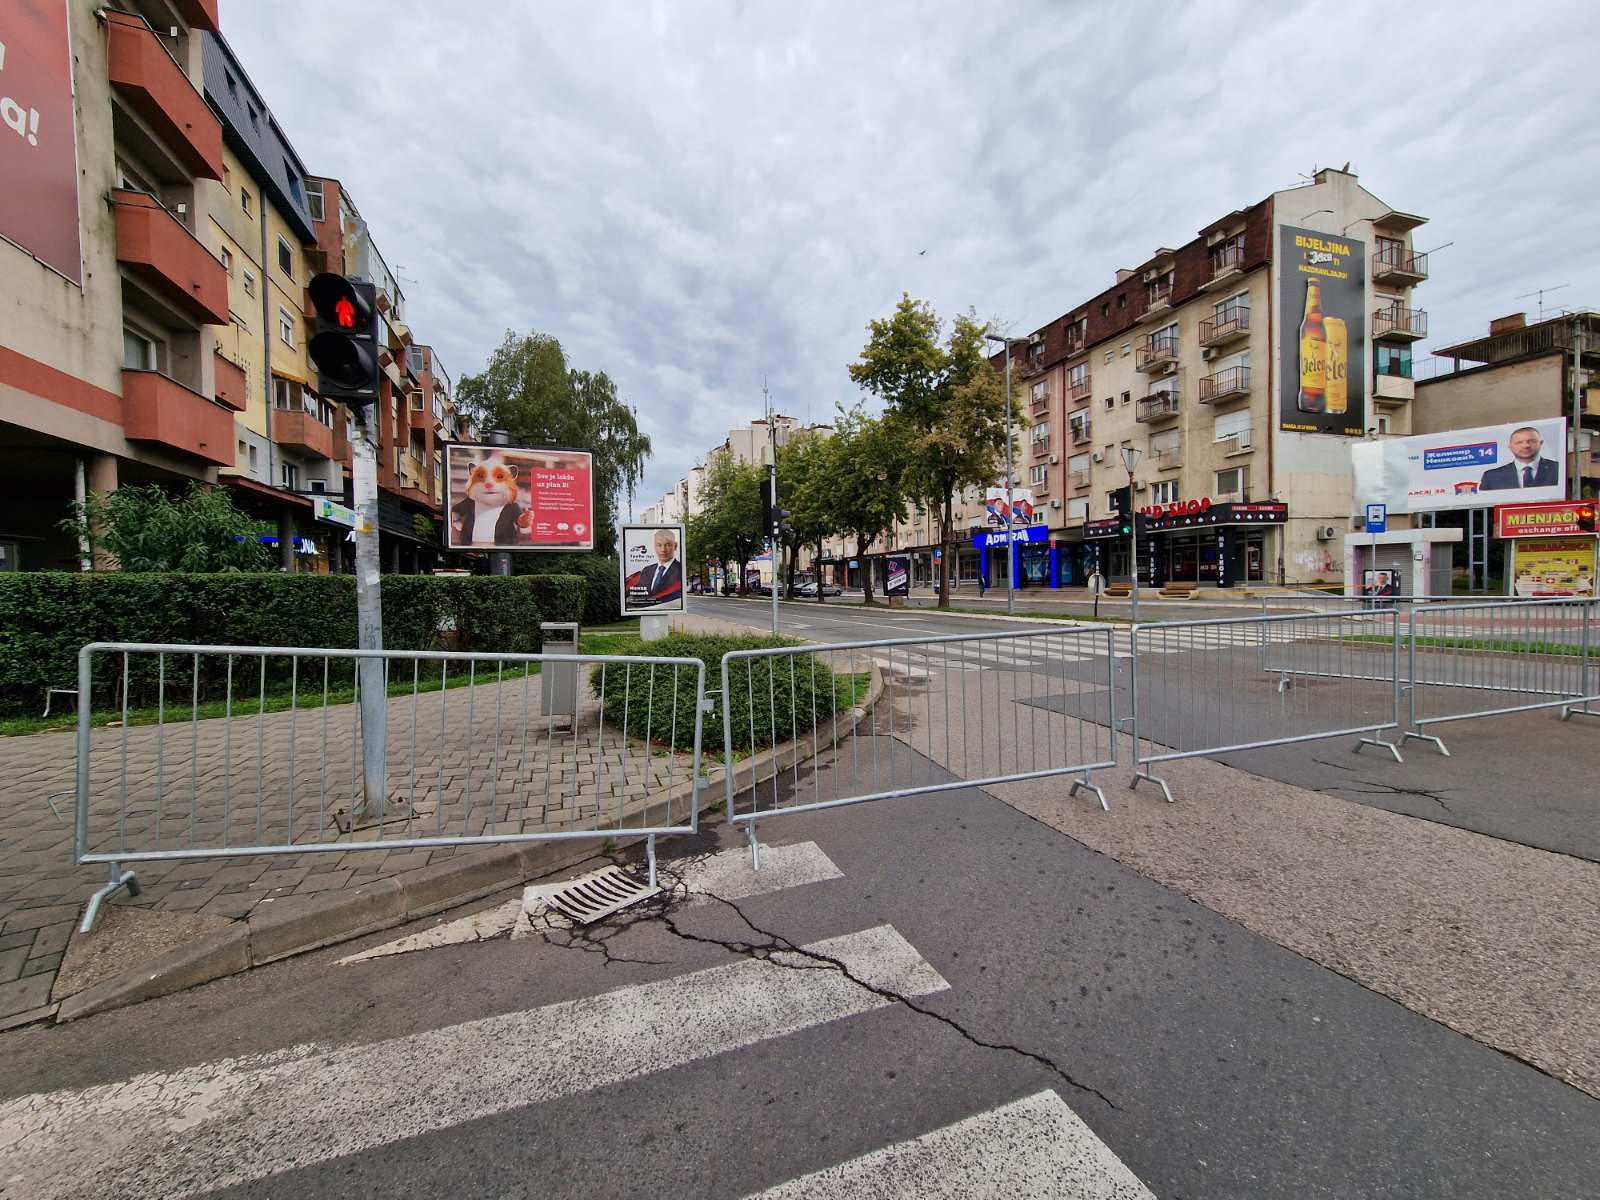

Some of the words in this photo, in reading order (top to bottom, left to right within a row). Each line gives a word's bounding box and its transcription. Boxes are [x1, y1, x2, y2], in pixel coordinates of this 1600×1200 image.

[1295, 235, 1351, 256] BIJELJINA
[1479, 448, 1494, 457] 14
[1168, 498, 1212, 517] SHOP
[985, 529, 1030, 545] ADMRAL
